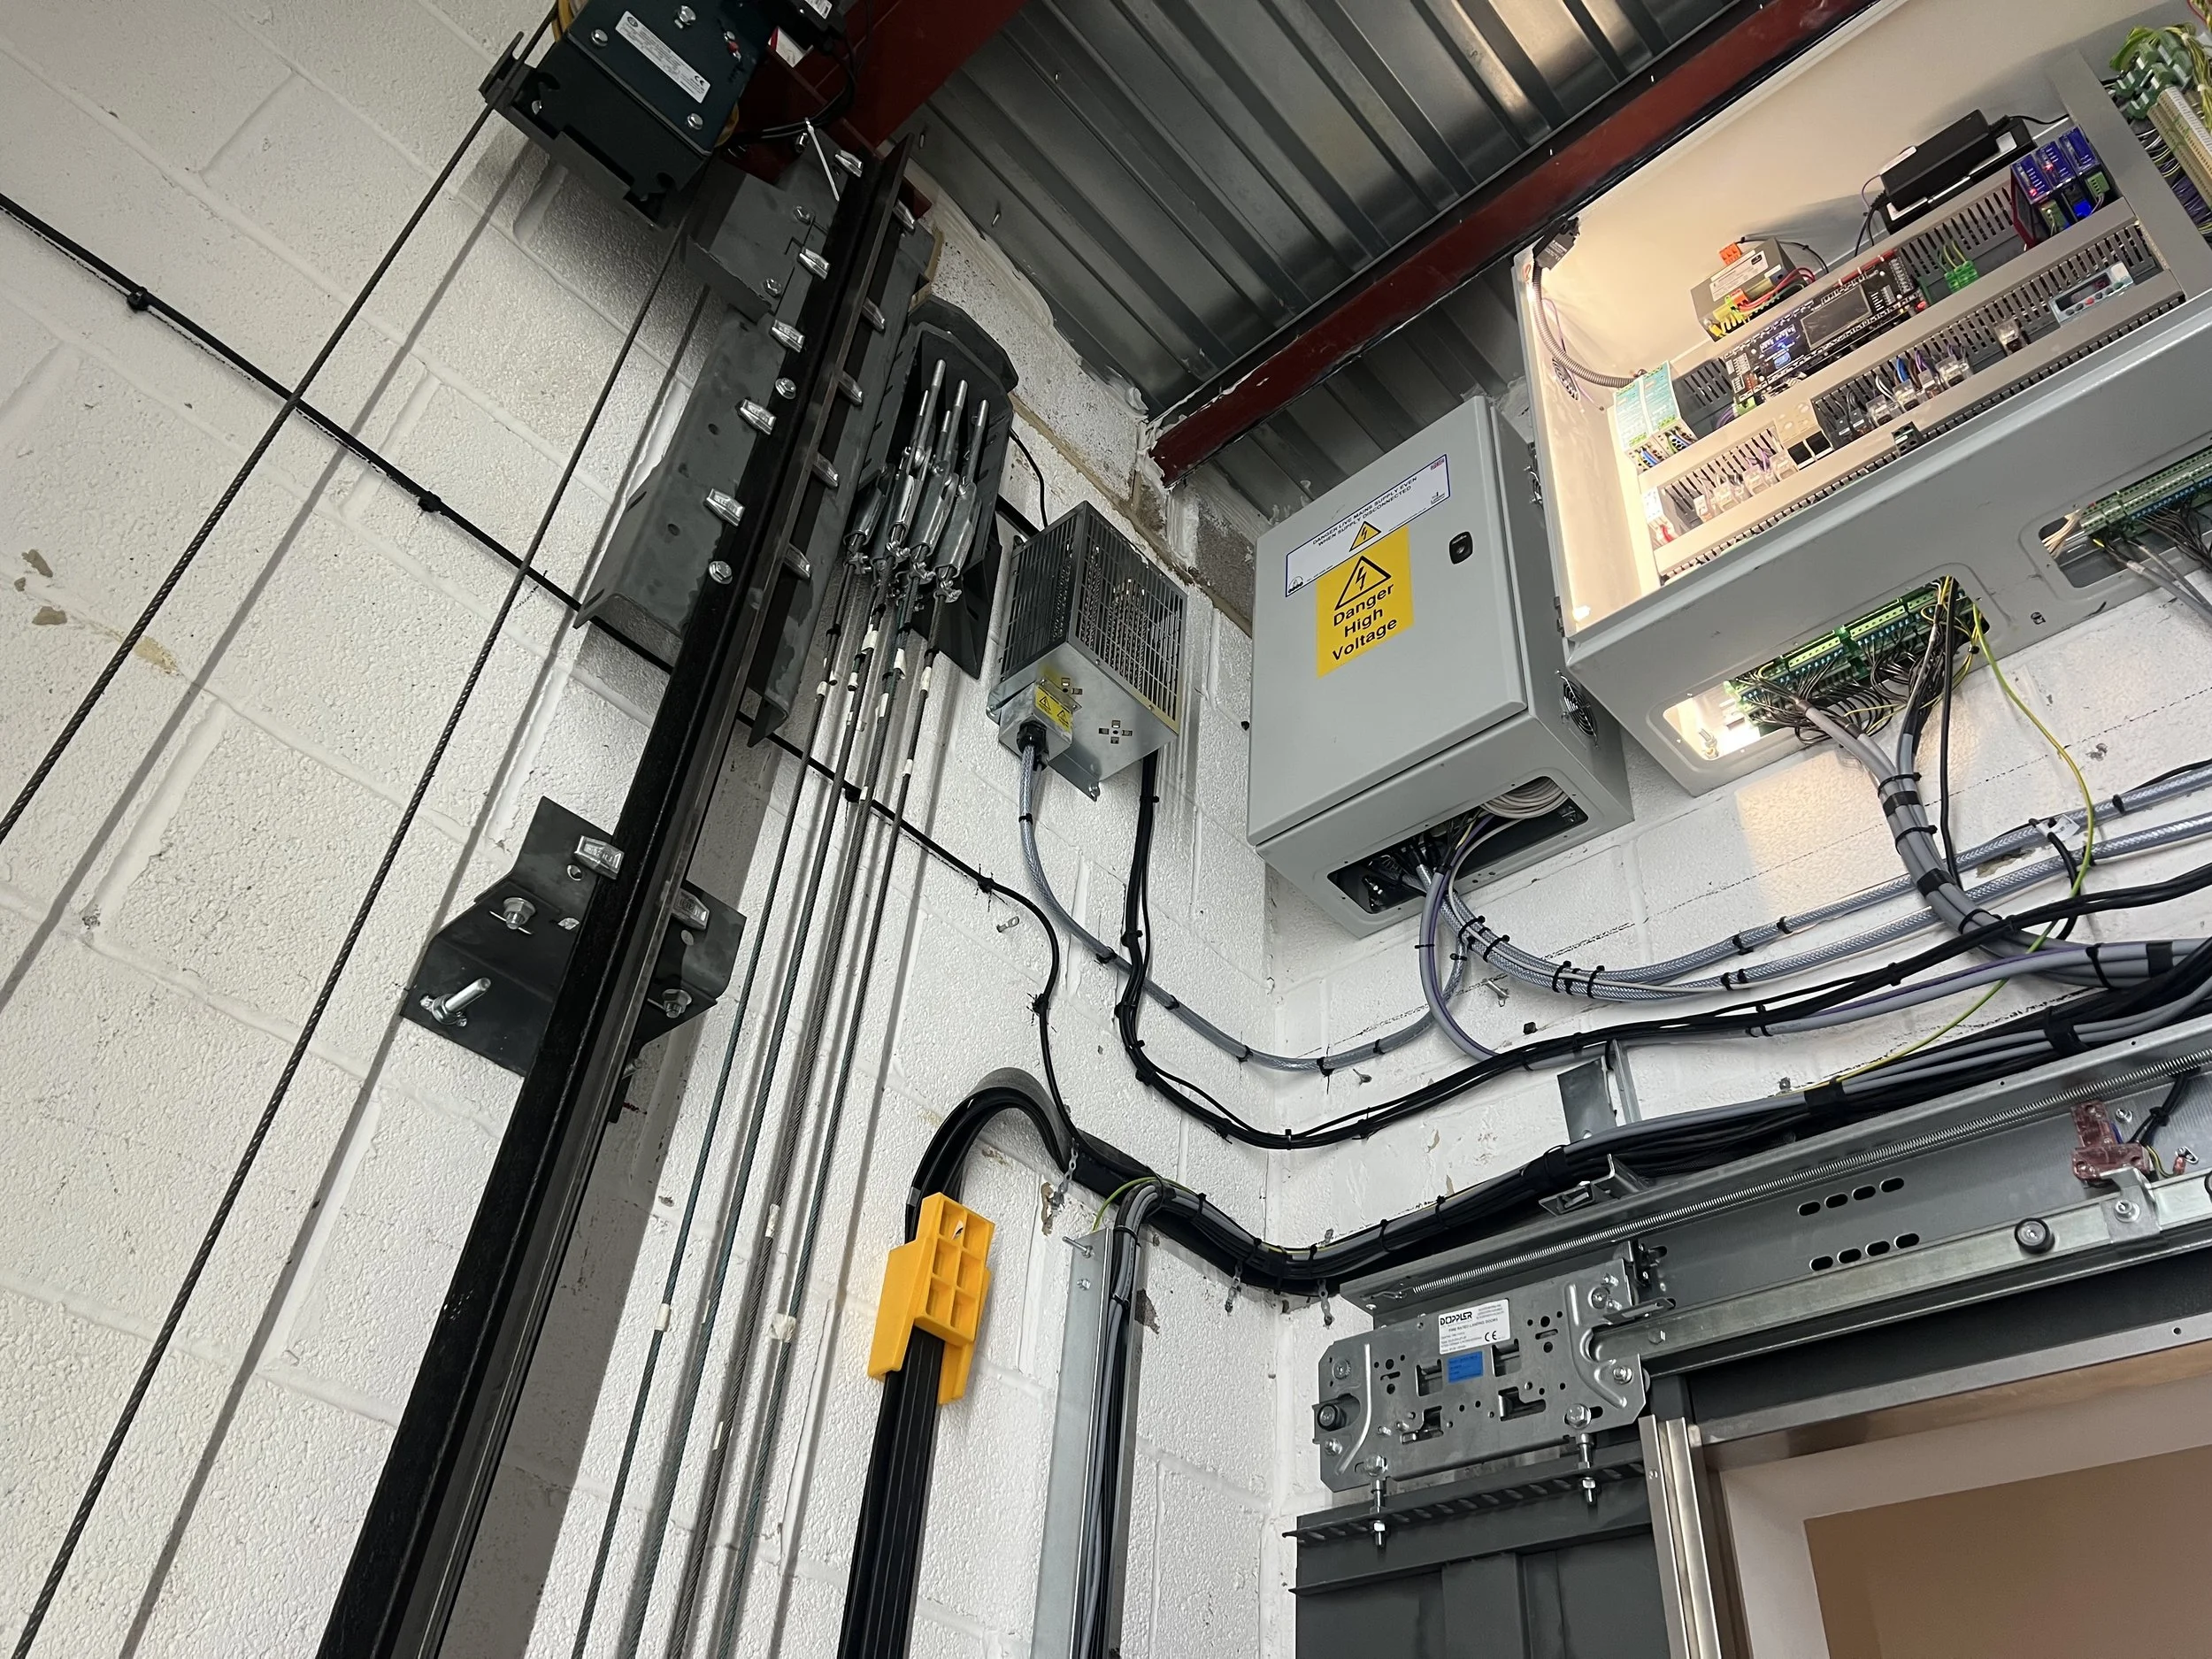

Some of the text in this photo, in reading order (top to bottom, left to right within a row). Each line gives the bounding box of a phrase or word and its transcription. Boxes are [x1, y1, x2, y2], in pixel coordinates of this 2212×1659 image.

[1313, 476, 1417, 544] DANGER LIVE MAINS SUPPLY EVEN
[1318, 533, 1336, 546] WHEN
[1338, 517, 1362, 534] SUPPLY
[1363, 486, 1411, 518] DISCONNECTED
[1333, 584, 1394, 626] Danger
[1345, 609, 1383, 637] High
[1333, 619, 1397, 660] Voltage
[1440, 1311, 1472, 1325] DOPPLER
